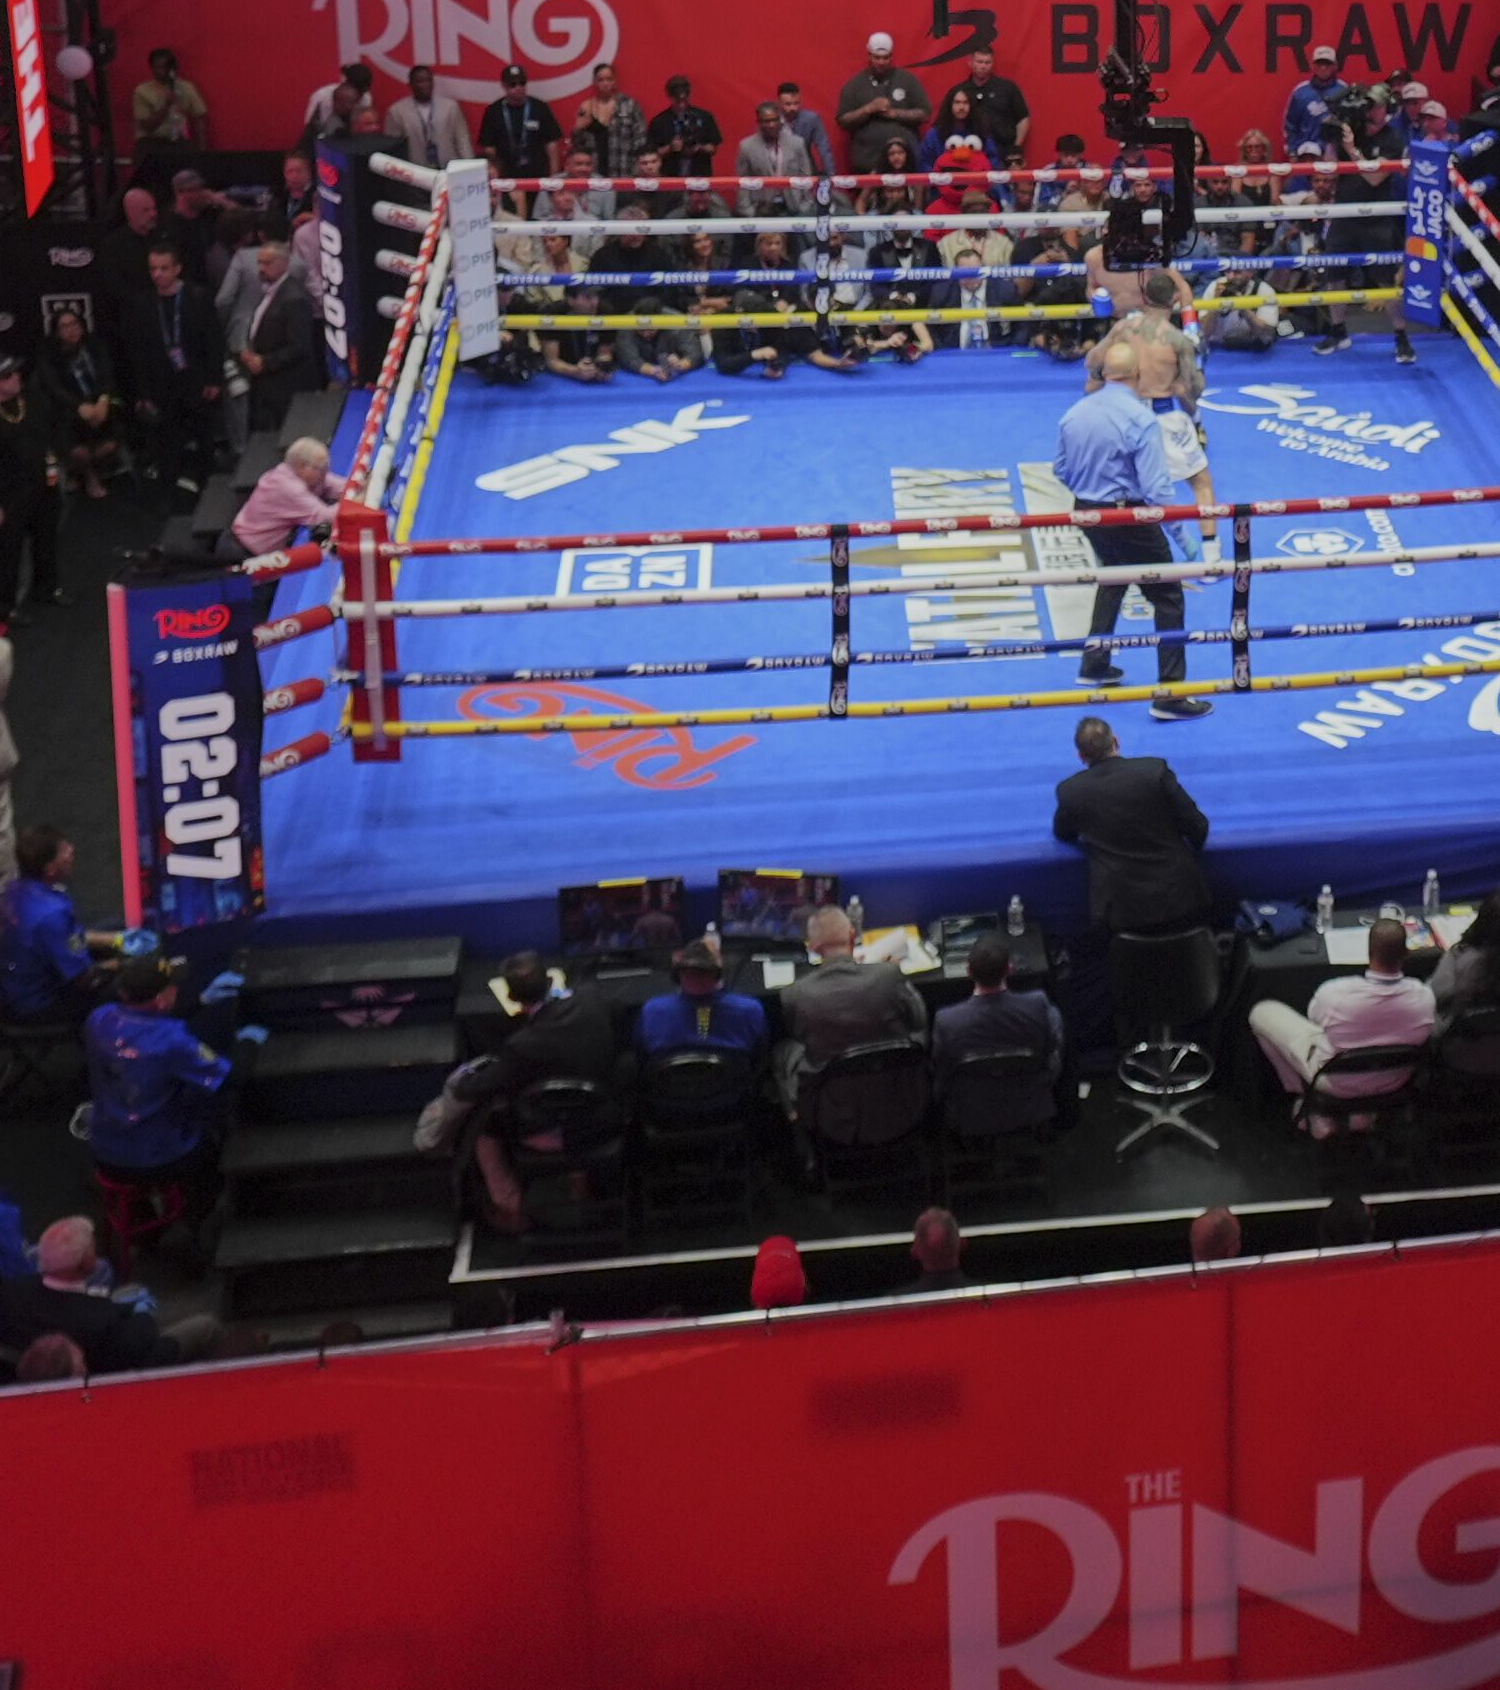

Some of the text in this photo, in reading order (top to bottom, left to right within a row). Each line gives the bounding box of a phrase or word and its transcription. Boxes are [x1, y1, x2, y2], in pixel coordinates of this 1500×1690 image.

[1052, 2, 1472, 74] BOXRAW
[1427, 189, 1444, 240] JACO
[475, 401, 752, 500] SNK
[1256, 418, 1365, 454] Welcome
[1279, 437, 1391, 472] to Arabia
[153, 604, 232, 640] RING
[171, 640, 239, 665] BOXRAW
[158, 691, 243, 881] 02:07
[1125, 1469, 1182, 1504] THE
